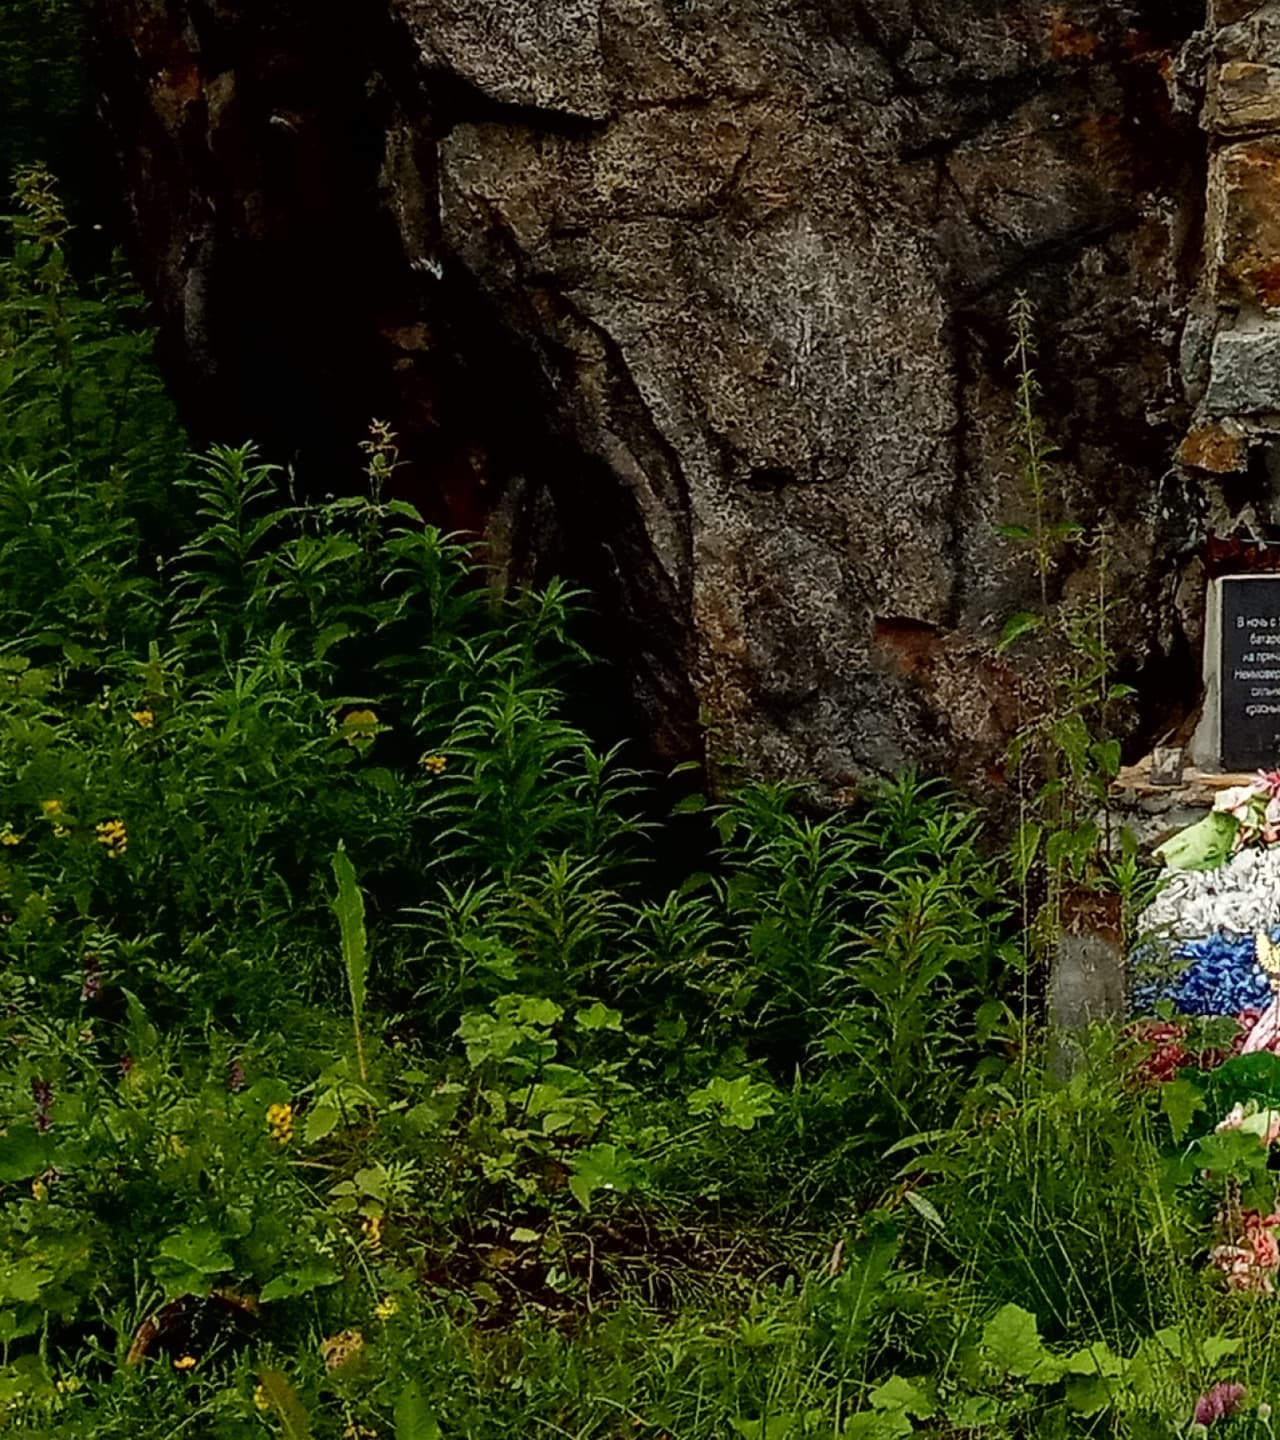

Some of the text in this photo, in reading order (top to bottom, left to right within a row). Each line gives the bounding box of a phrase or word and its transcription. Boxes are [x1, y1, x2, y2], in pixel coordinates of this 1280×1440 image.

[1237, 616, 1245, 628] В
[1246, 618, 1268, 628] ночь
[1270, 618, 1276, 627] с
[1242, 653, 1255, 662] на
